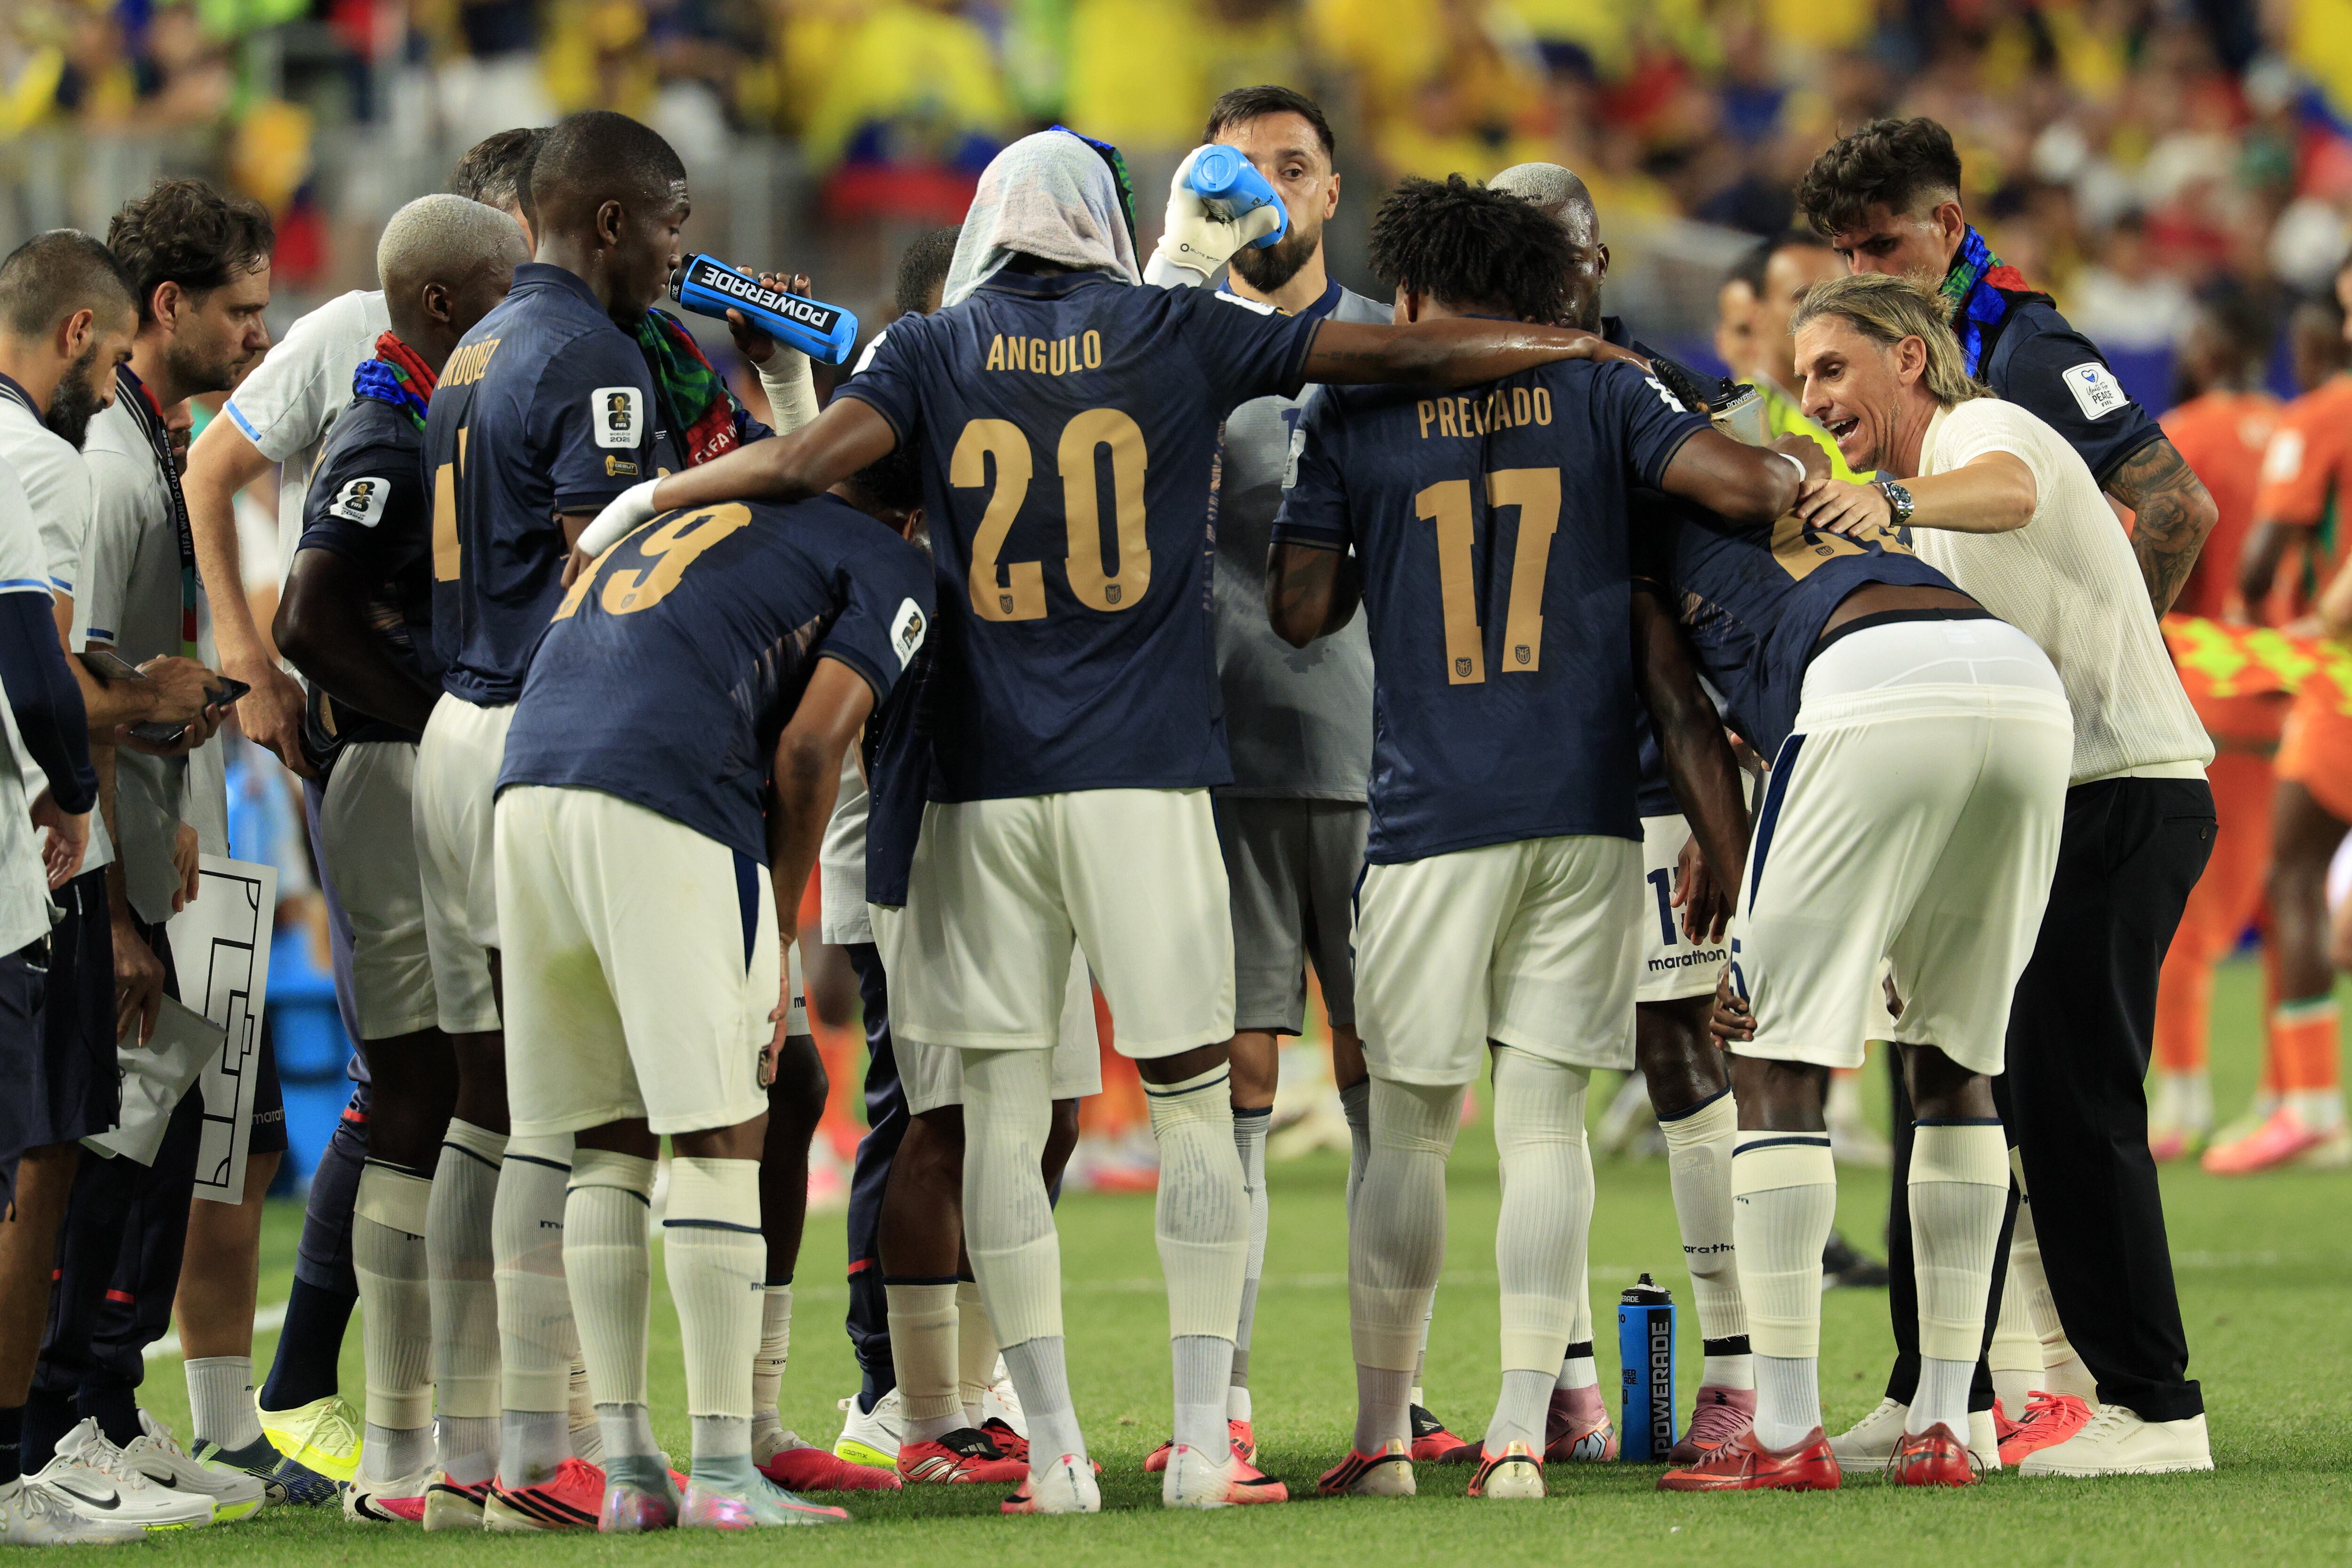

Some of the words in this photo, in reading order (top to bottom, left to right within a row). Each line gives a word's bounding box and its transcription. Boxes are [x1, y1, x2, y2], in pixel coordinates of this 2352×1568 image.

[701, 266, 830, 328] POWERADE
[986, 329, 1102, 376] ANGULO
[1726, 389, 1757, 408] POWERAD
[2086, 385, 2101, 396] Unite
[2092, 390, 2114, 404] PEACE
[695, 433, 730, 464] FIFA
[170, 469, 180, 490] CUP
[174, 491, 189, 530] WORLD
[949, 407, 1152, 622] 20
[180, 532, 192, 556] FIFA
[1415, 467, 1562, 685] 17
[1648, 947, 1727, 971] marathon
[1651, 1321, 1671, 1455] POWERADE
